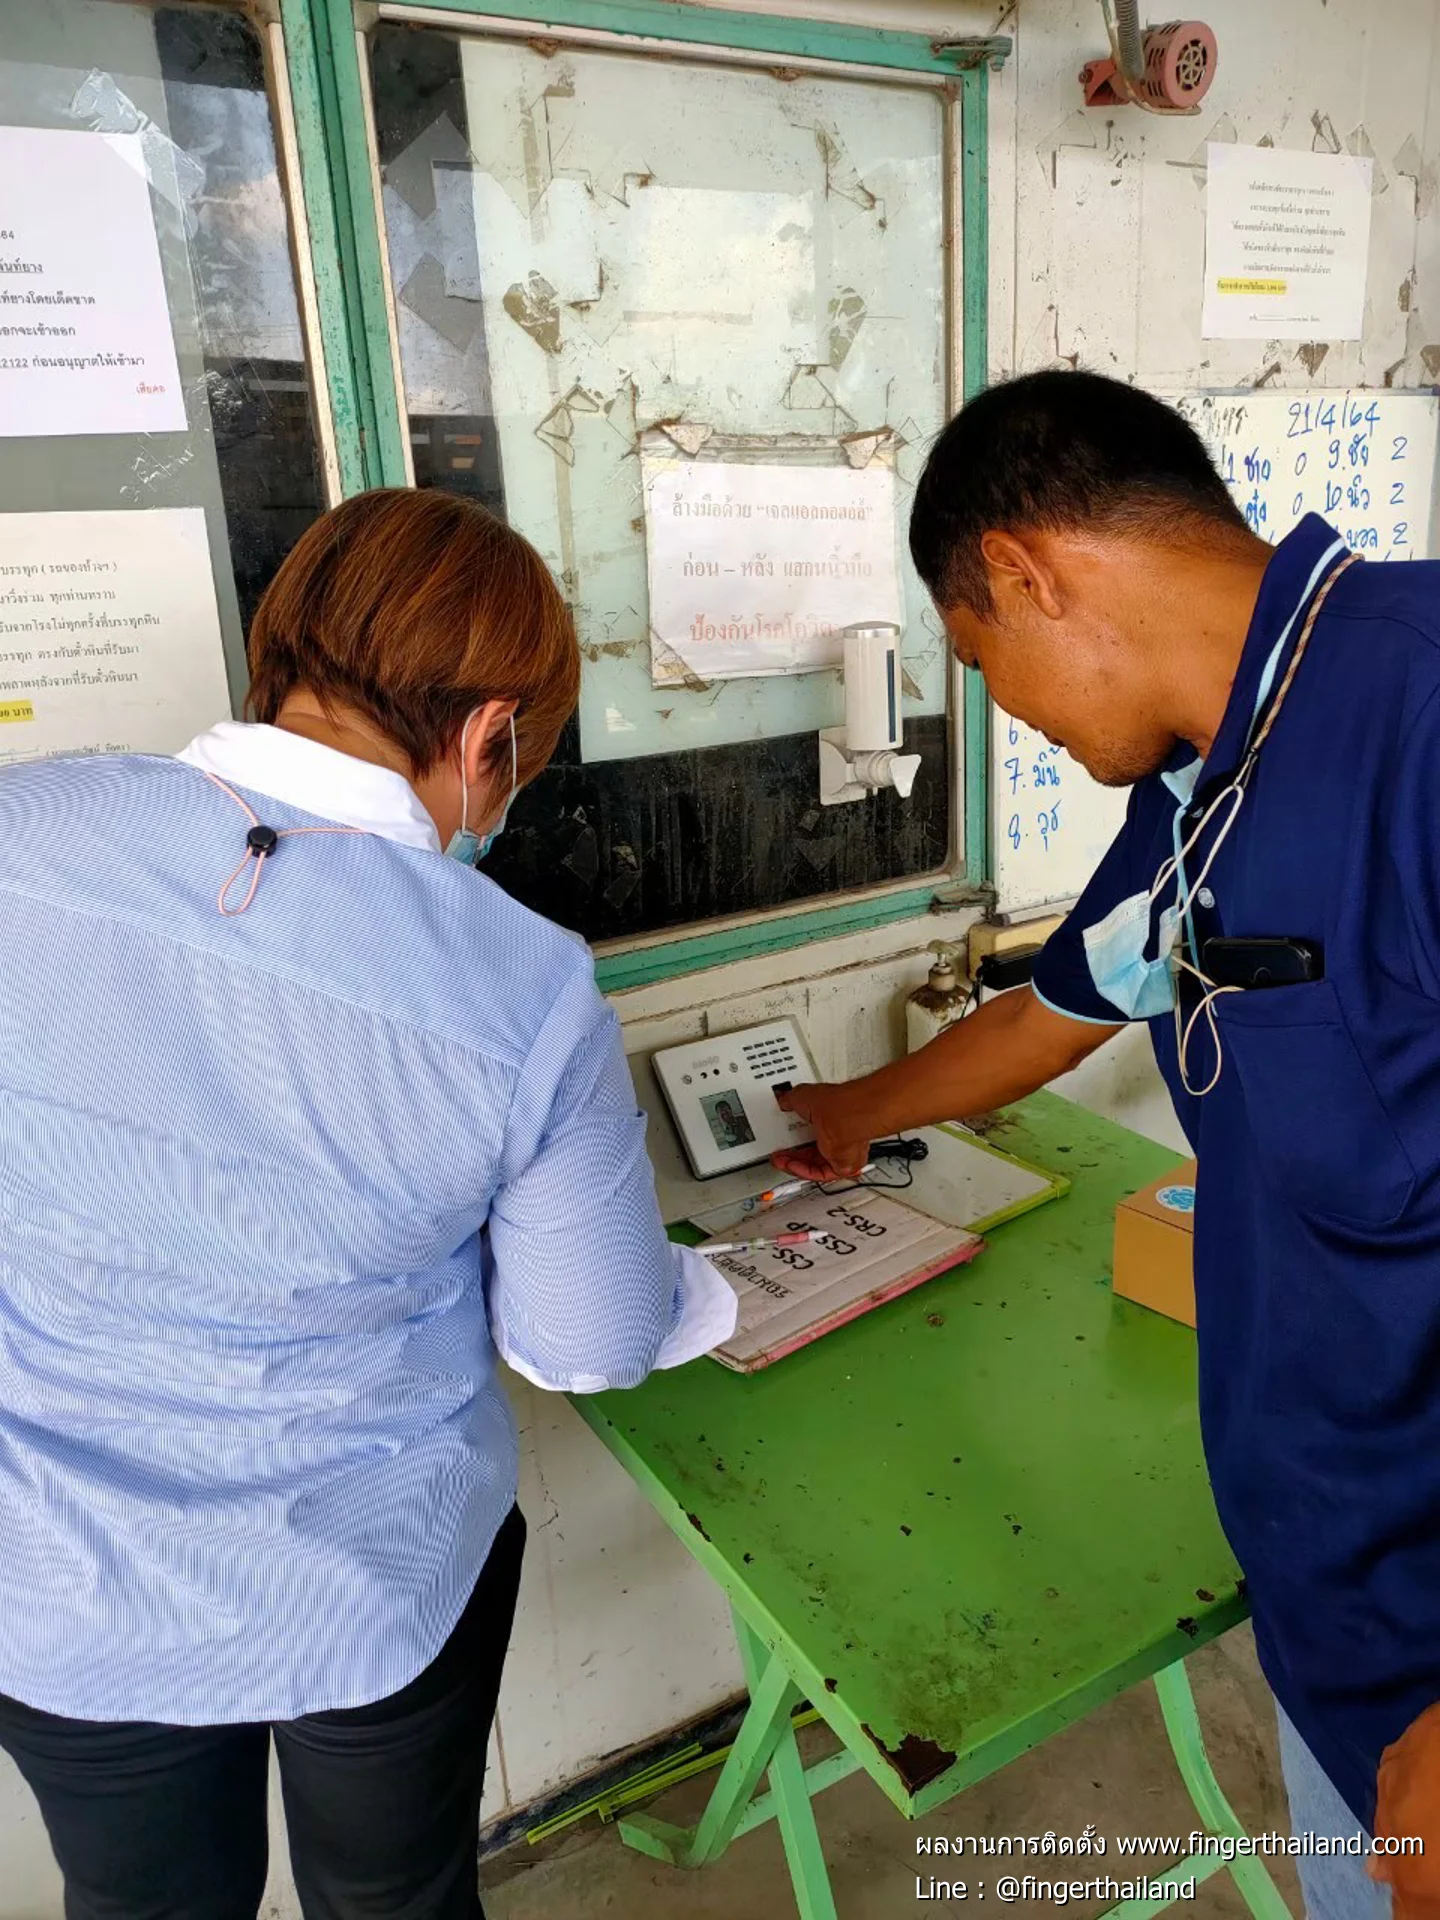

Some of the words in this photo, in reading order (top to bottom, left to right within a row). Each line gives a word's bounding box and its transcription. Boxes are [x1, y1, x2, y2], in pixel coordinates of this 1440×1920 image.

[0, 229, 15, 241] 64
[0, 289, 96, 306] ท์ยางโดยเด็ดขาด
[0, 322, 76, 337] อกจะเข้าออก
[0, 357, 29, 369] 2122
[1391, 437, 1408, 460] 2
[1389, 482, 1405, 504] 2
[672, 493, 752, 519] ล้างมือด้วย
[1392, 522, 1408, 545] 2
[683, 552, 719, 577] ก่อน
[741, 553, 773, 577] หลัง
[826, 1205, 888, 1238] CRS-2
